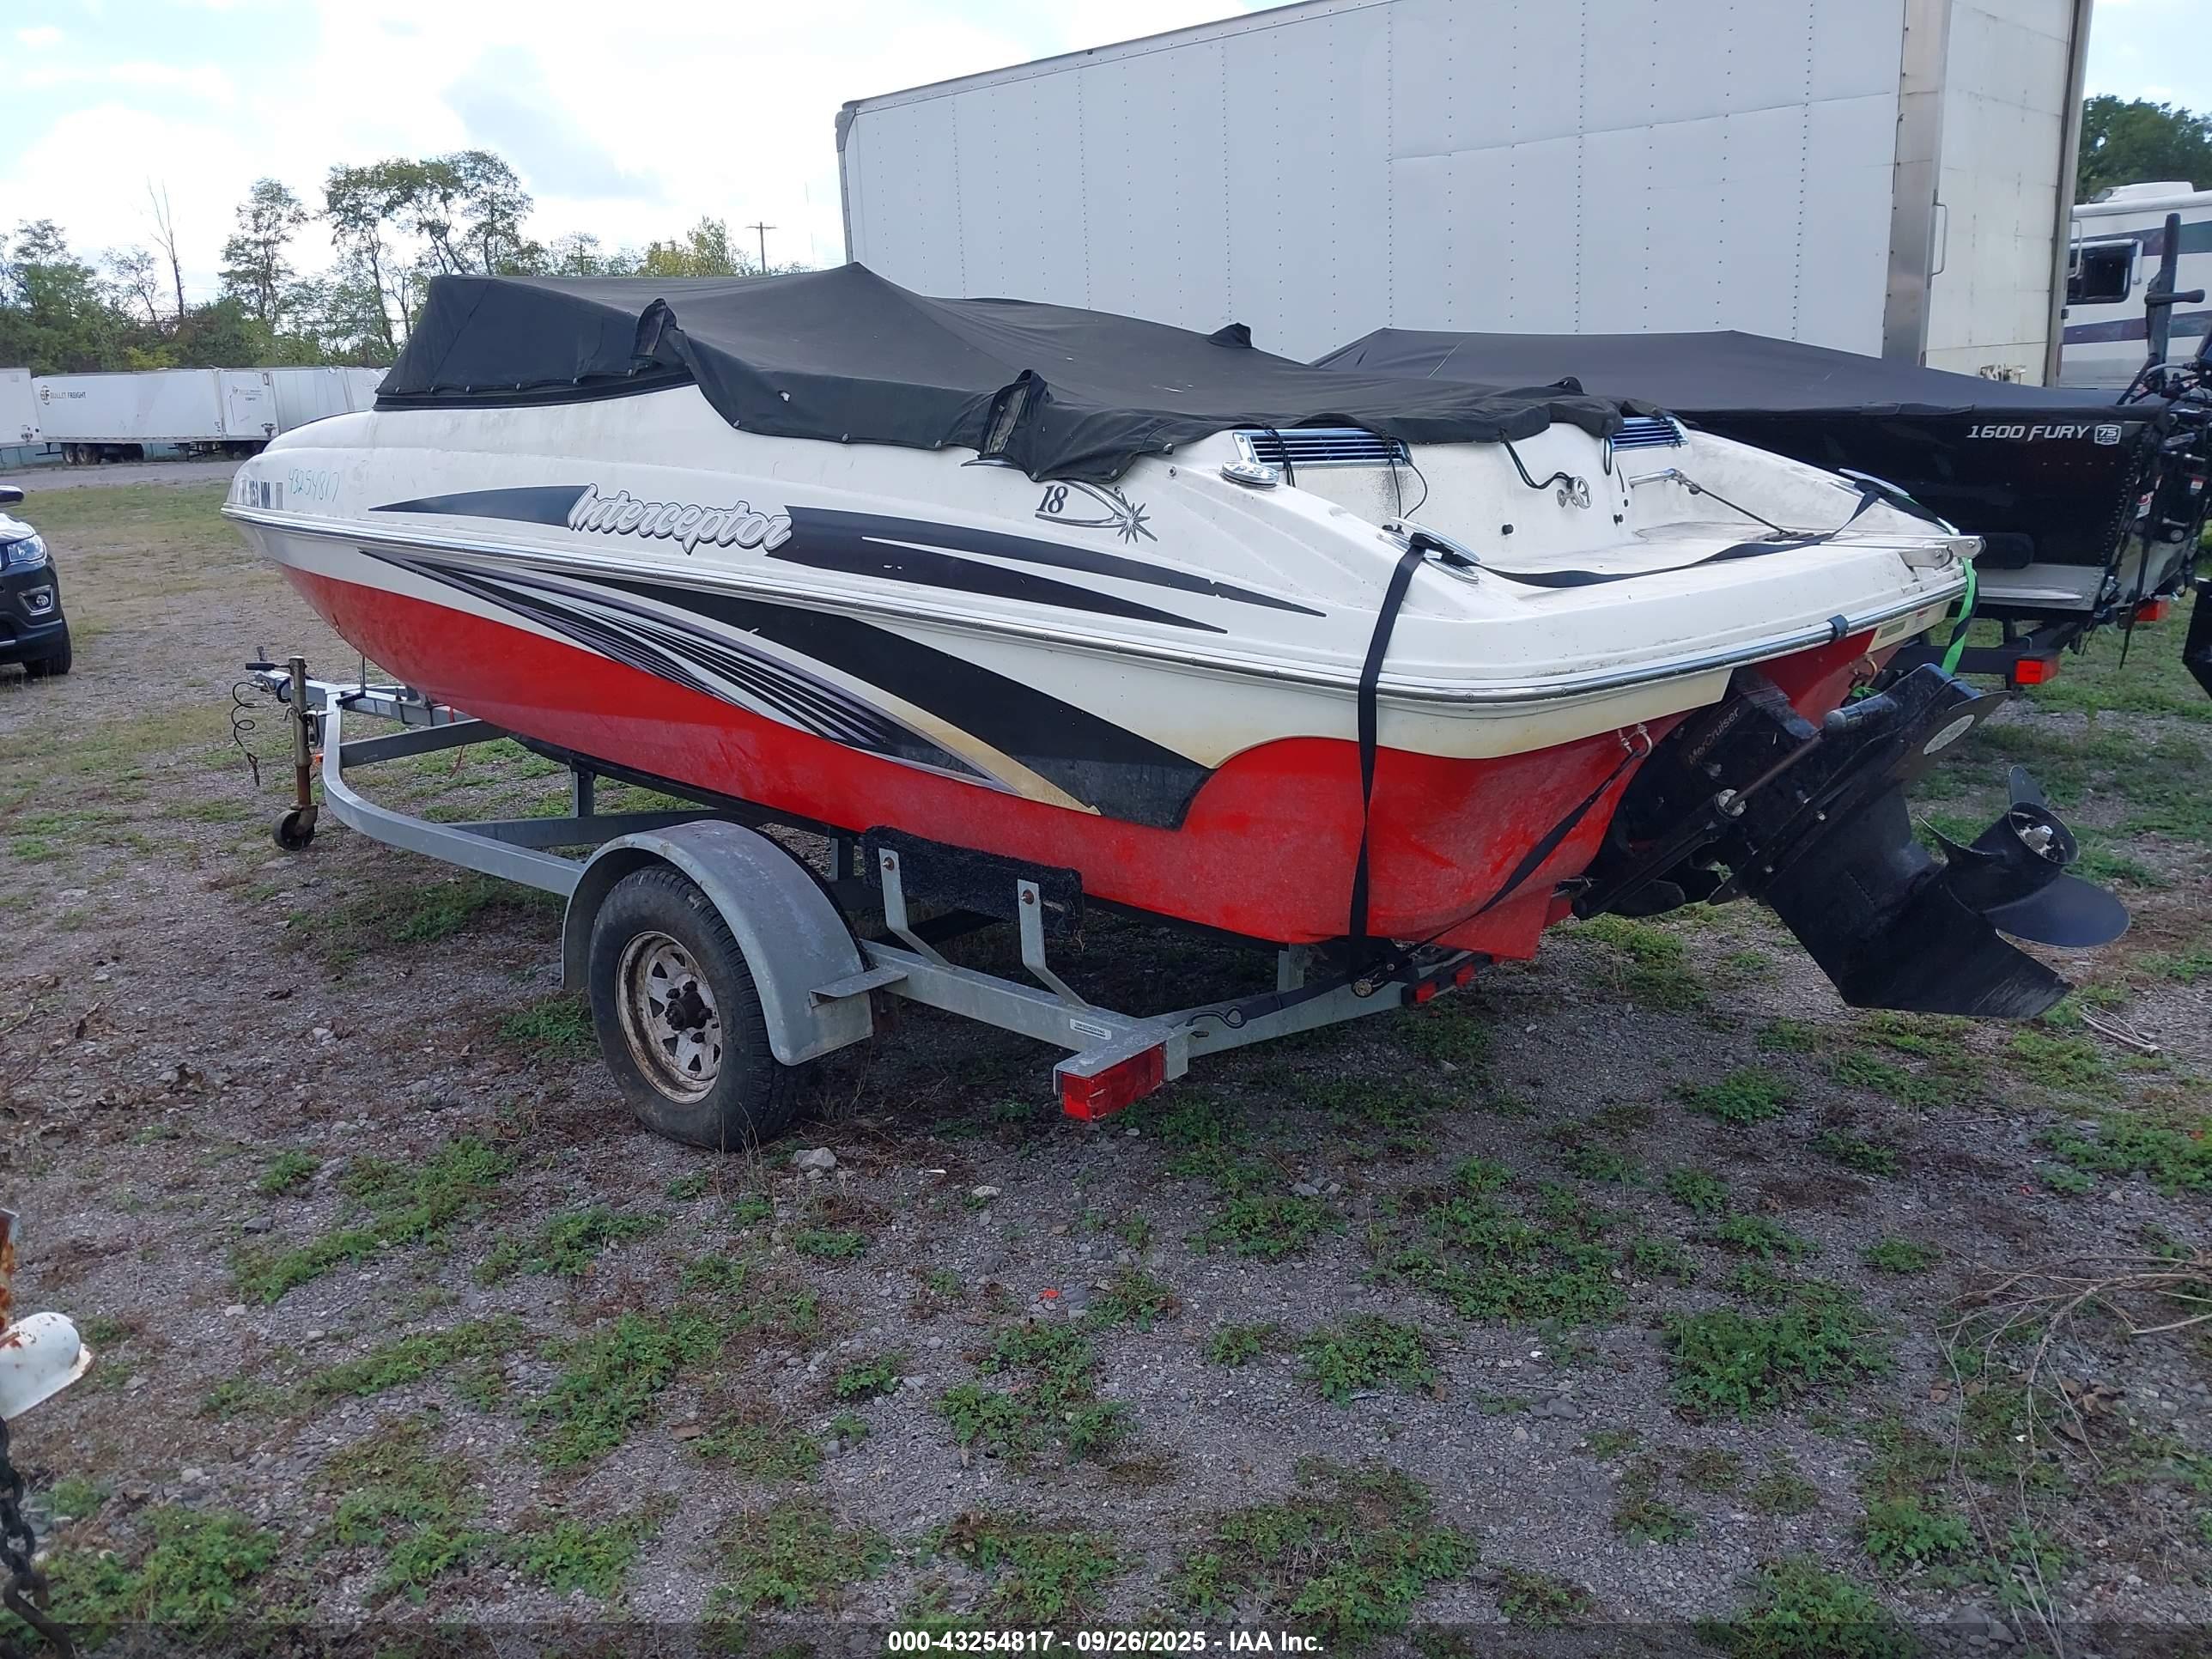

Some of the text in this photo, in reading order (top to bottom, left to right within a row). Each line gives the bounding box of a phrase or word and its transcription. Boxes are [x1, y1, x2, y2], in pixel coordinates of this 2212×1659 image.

[1966, 425, 2091, 441] 1600 FURY
[2099, 428, 2118, 437] 75
[288, 467, 340, 502] 43254817
[1035, 484, 1069, 514] 18
[568, 483, 793, 556] Interceptor
[1688, 707, 1739, 765] MerCruiser
